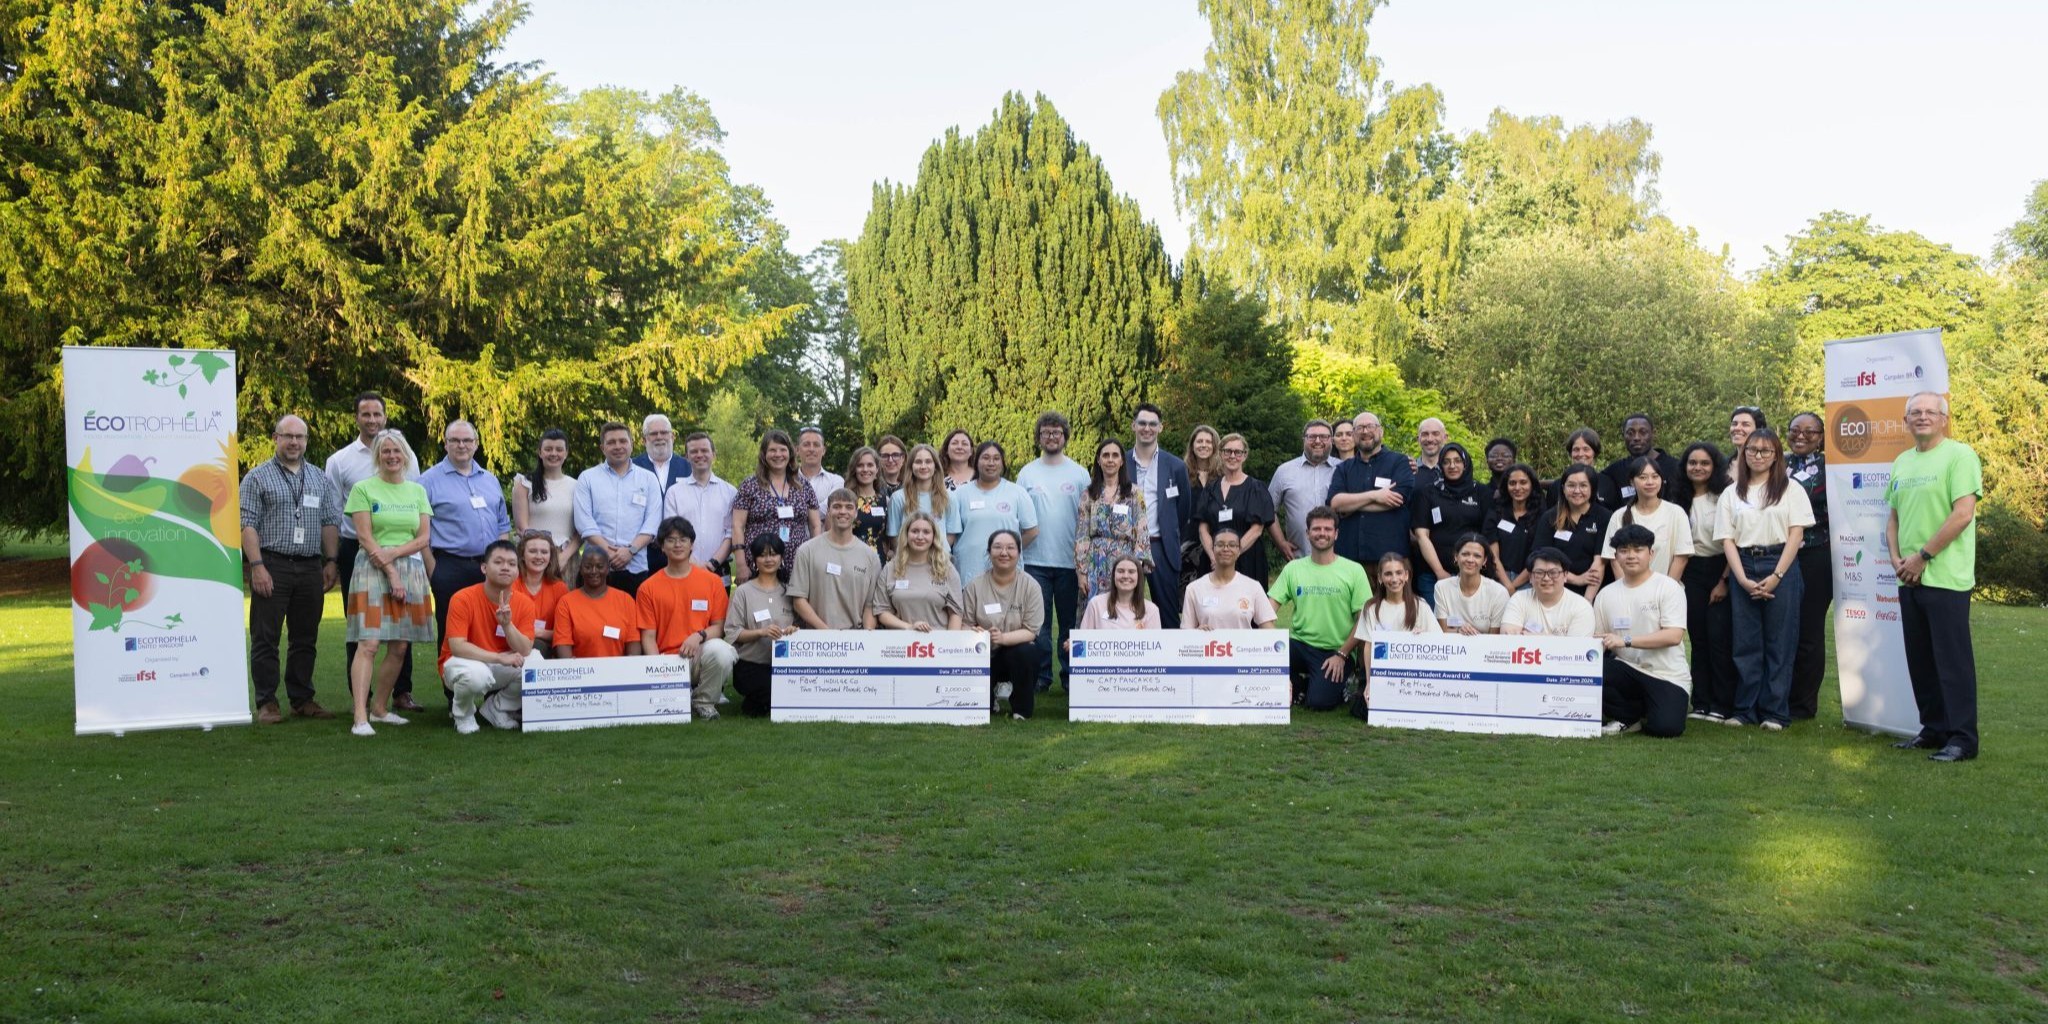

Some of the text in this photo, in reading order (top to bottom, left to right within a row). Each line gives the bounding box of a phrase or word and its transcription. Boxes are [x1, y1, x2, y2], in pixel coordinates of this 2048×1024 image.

[1857, 371, 1876, 386] ifst
[211, 410, 222, 418] UK
[1863, 473, 1891, 481] ECOTRO
[113, 512, 145, 525] eco
[104, 525, 187, 542] innovation
[1845, 572, 1863, 582] M&S
[138, 635, 198, 645] ECOTROPHELIA
[790, 641, 865, 651] ECOTROPHELIA
[907, 641, 935, 658] ifst
[938, 647, 964, 655] Campden
[1087, 641, 1162, 651] ECOTROPHELIA
[1204, 640, 1233, 657] ifst
[1390, 643, 1467, 655] ECOTROPHELIA
[1511, 647, 1542, 665] ifst
[1545, 654, 1573, 662] Campden
[537, 666, 595, 677] ECOTROPHELIA
[645, 665, 686, 674] MAGNUM
[136, 670, 156, 681] ifst
[537, 689, 551, 697] Safety
[863, 686, 877, 696] Only
[1162, 686, 1176, 695] Only
[1464, 692, 1479, 701] Only
